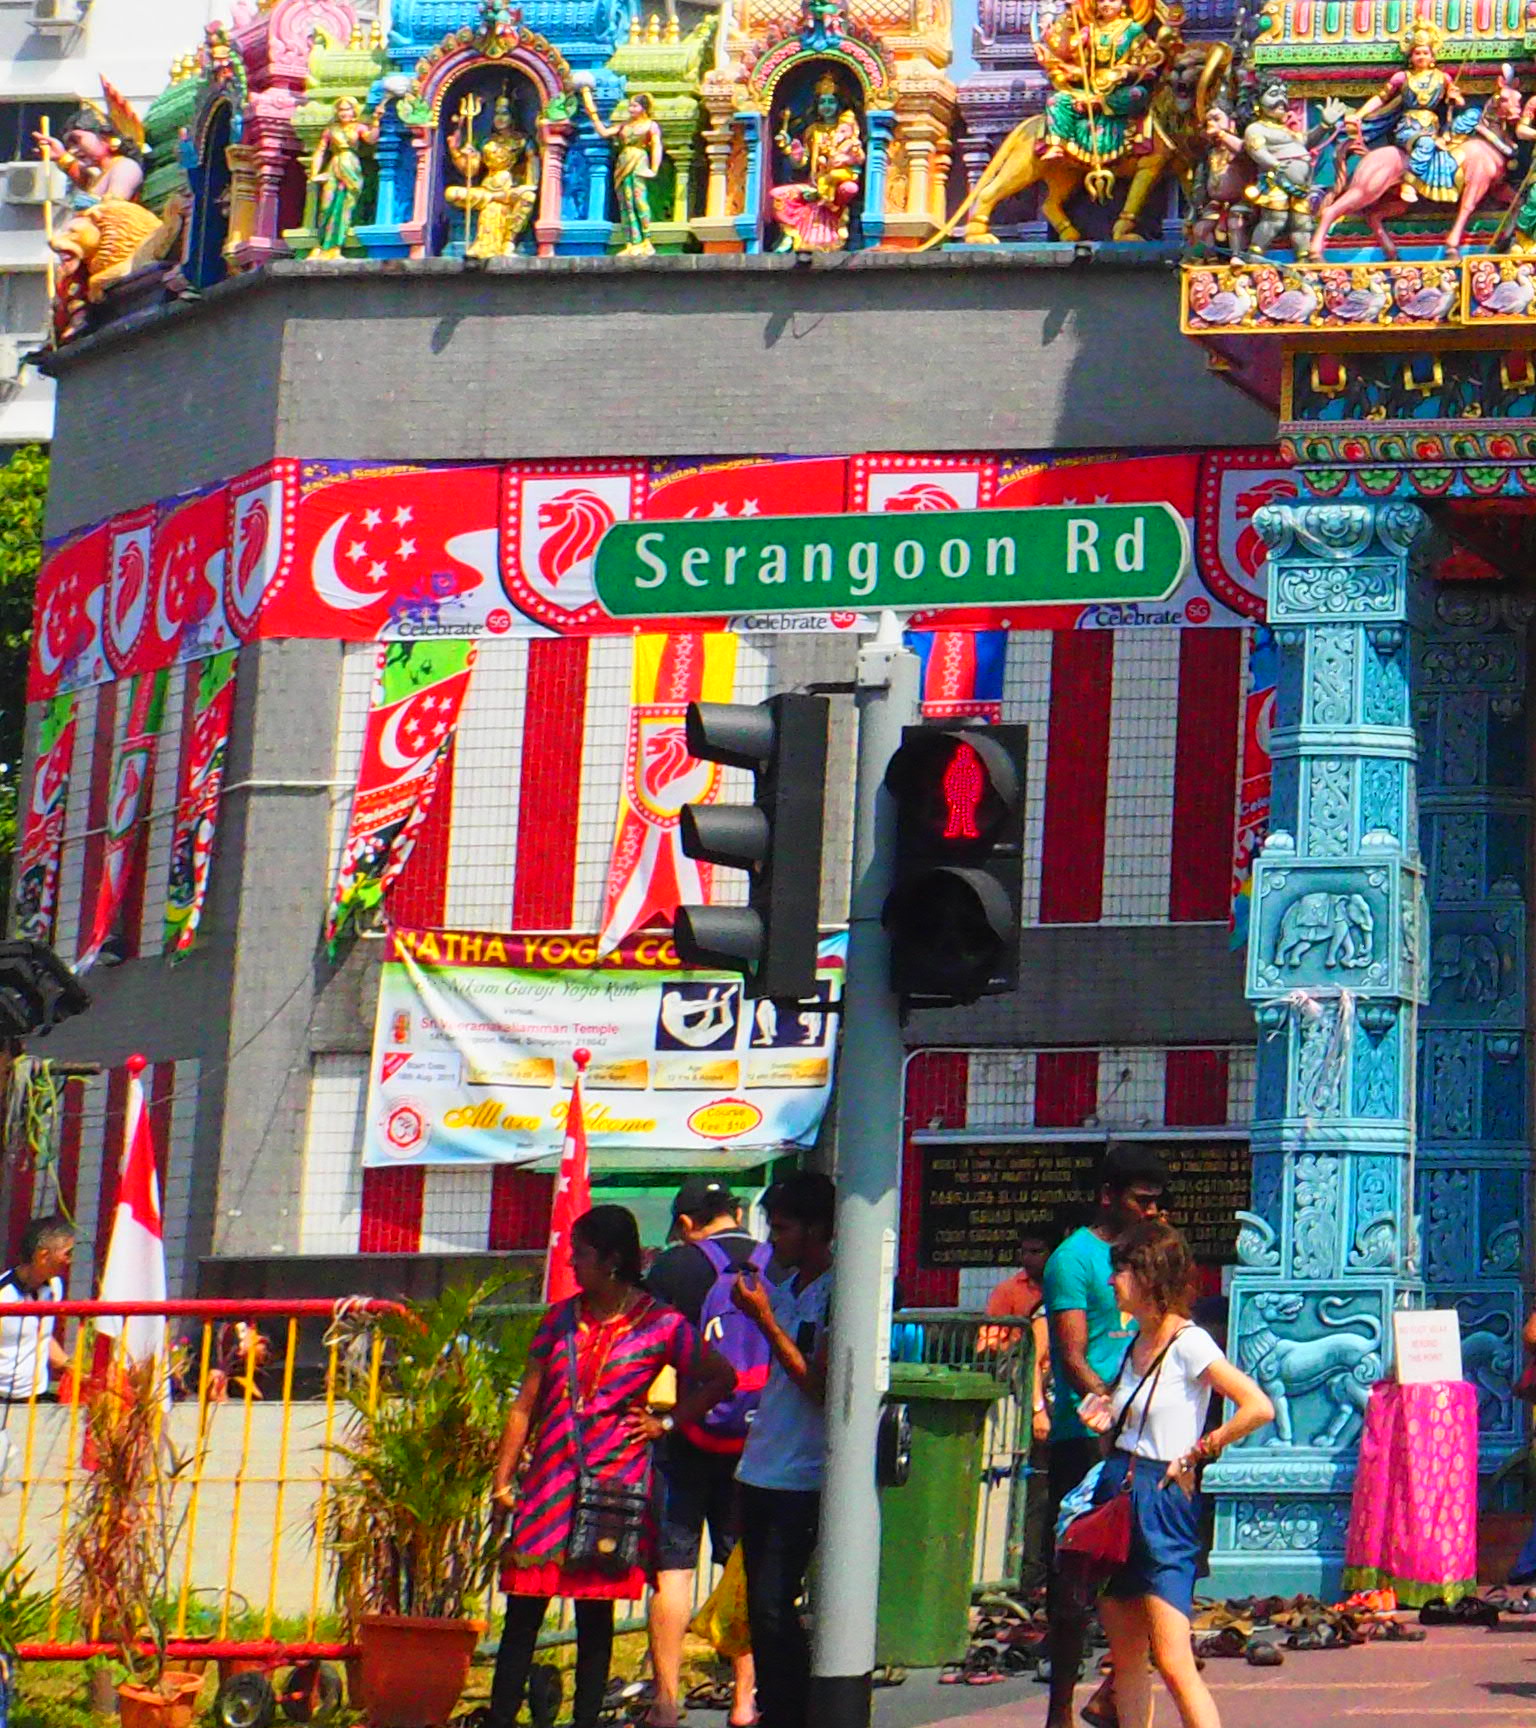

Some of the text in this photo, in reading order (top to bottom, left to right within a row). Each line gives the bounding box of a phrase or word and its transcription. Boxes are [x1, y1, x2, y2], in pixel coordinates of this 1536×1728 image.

[634, 516, 1145, 597] Serangoon Rd
[744, 615, 828, 631] Celebrate
[1094, 605, 1182, 626] Celebrate
[397, 621, 484, 637] Celebrate
